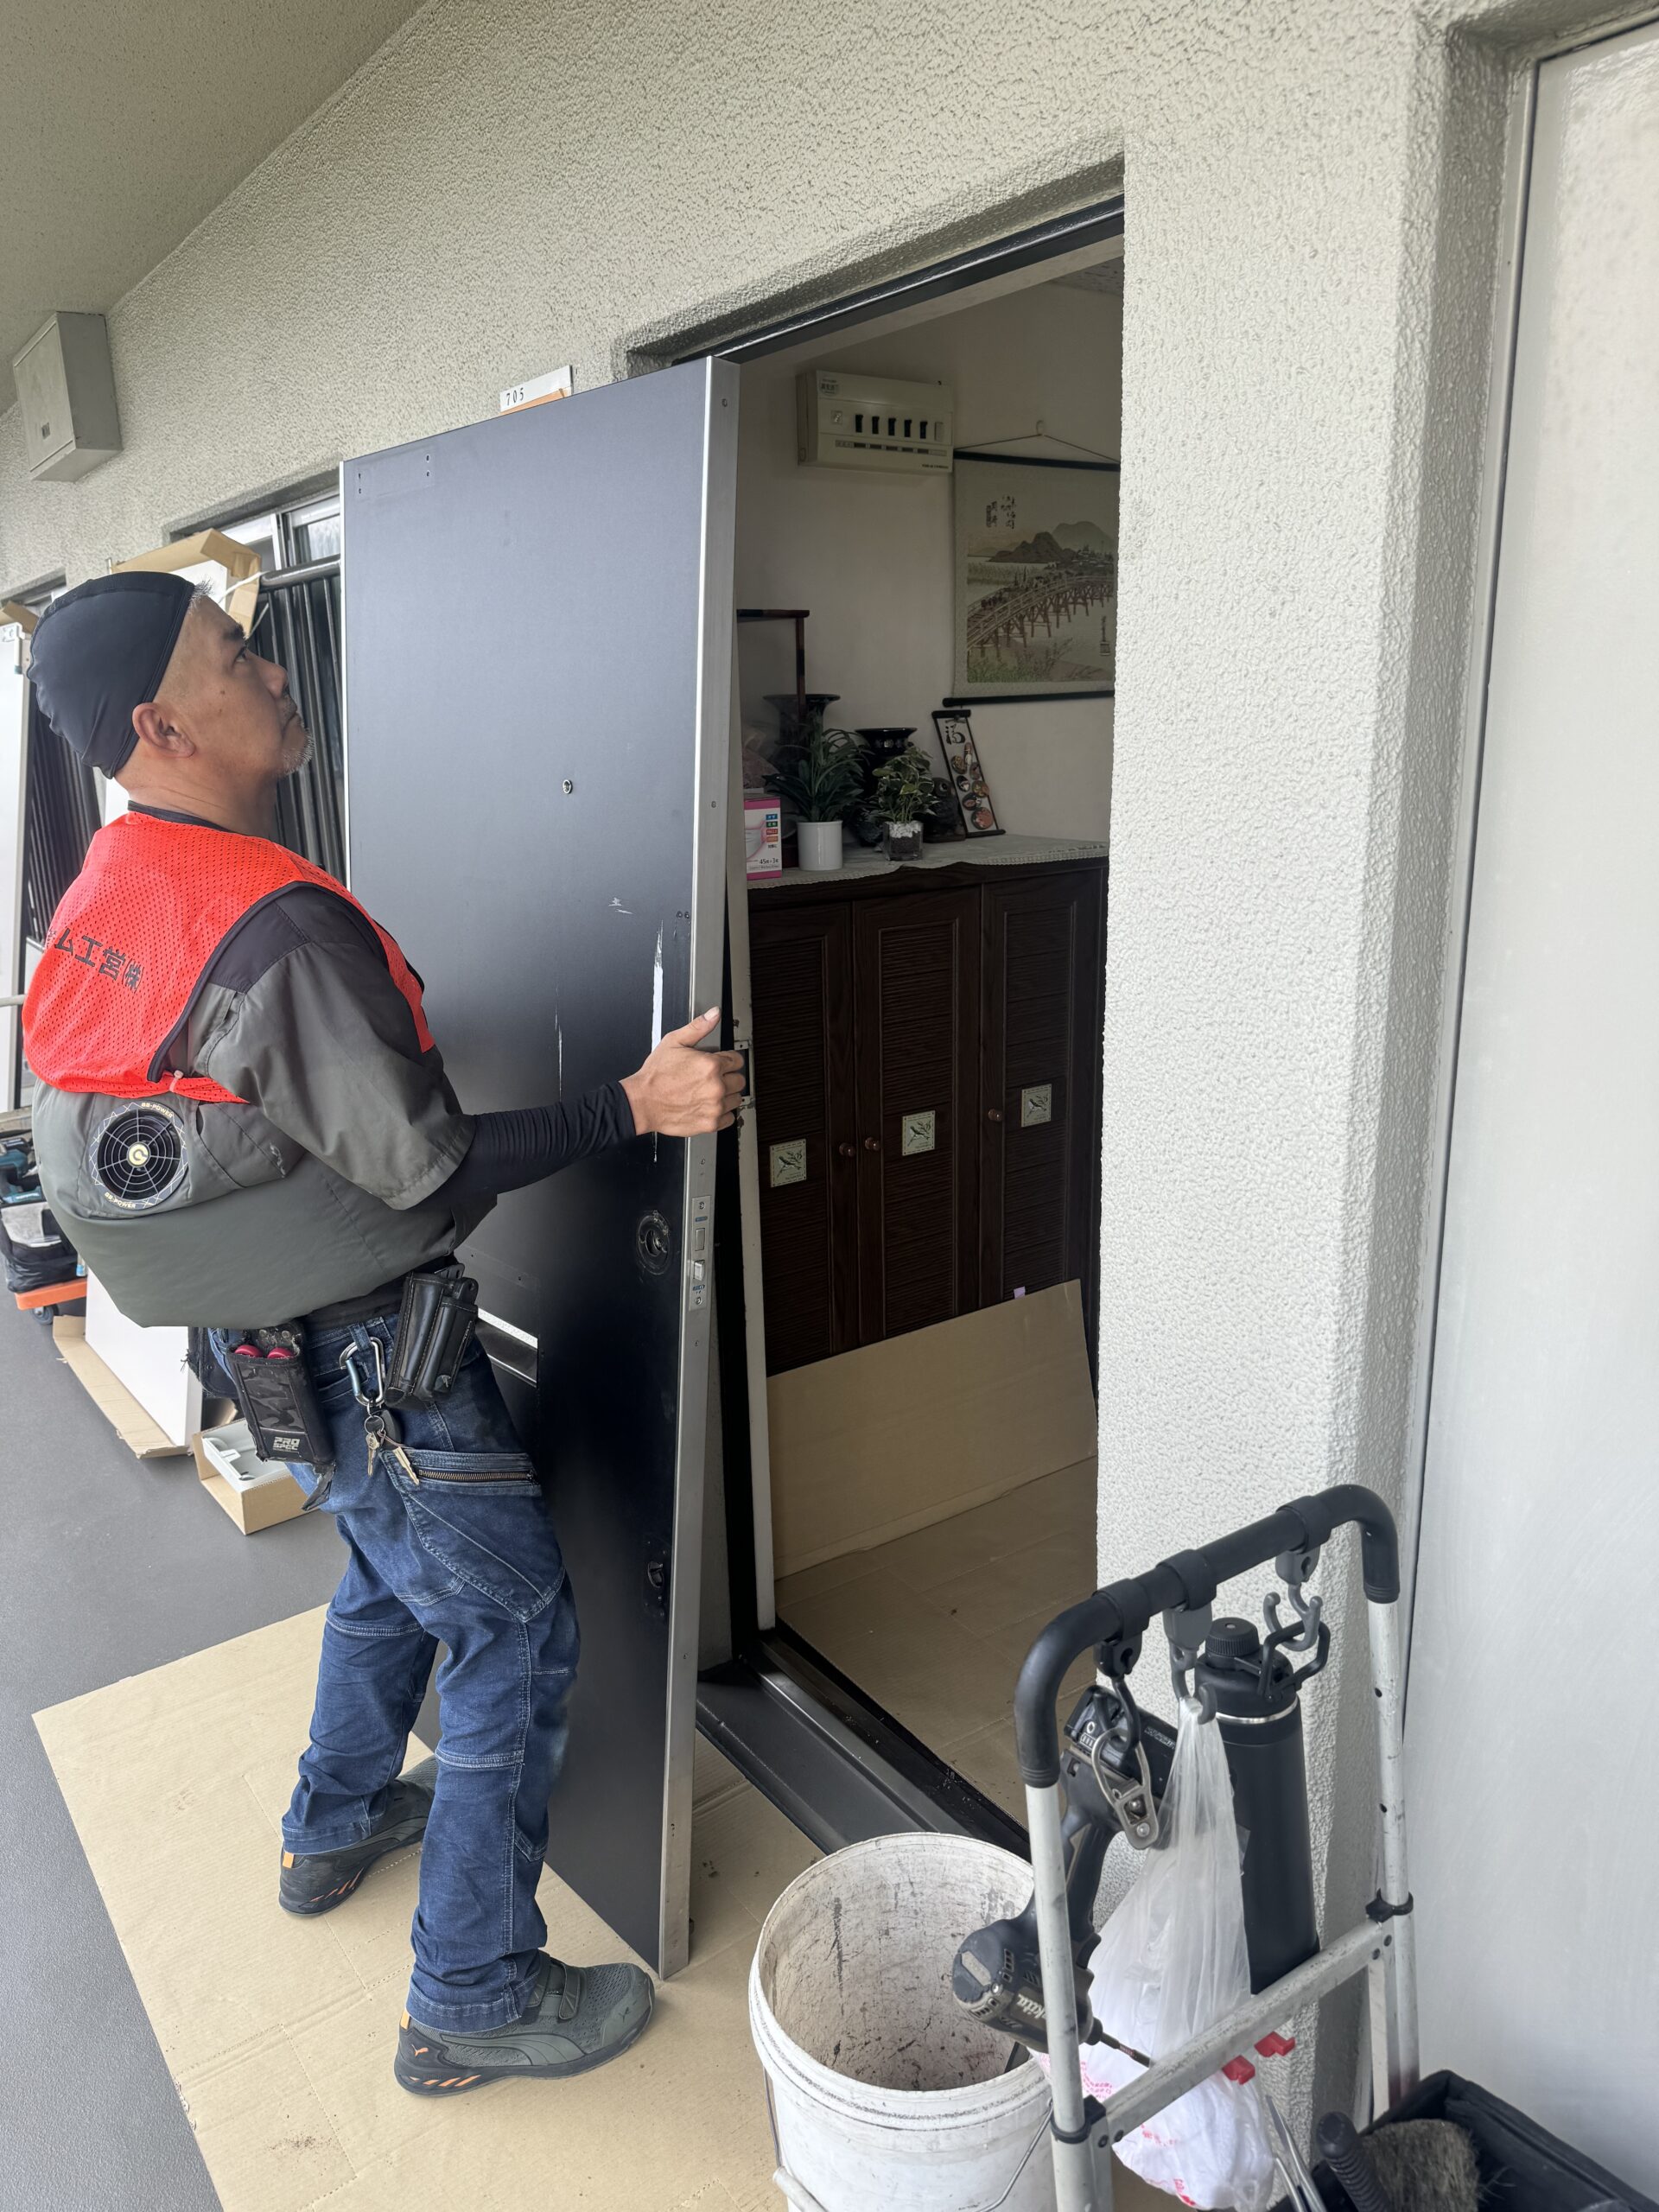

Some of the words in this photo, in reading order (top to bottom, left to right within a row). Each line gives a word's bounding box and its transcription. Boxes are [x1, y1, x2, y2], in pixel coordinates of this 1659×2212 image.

[506, 387, 524, 406] 705
[273, 1436, 301, 1446] PRO
[1017, 1993, 1046, 2019] kita
